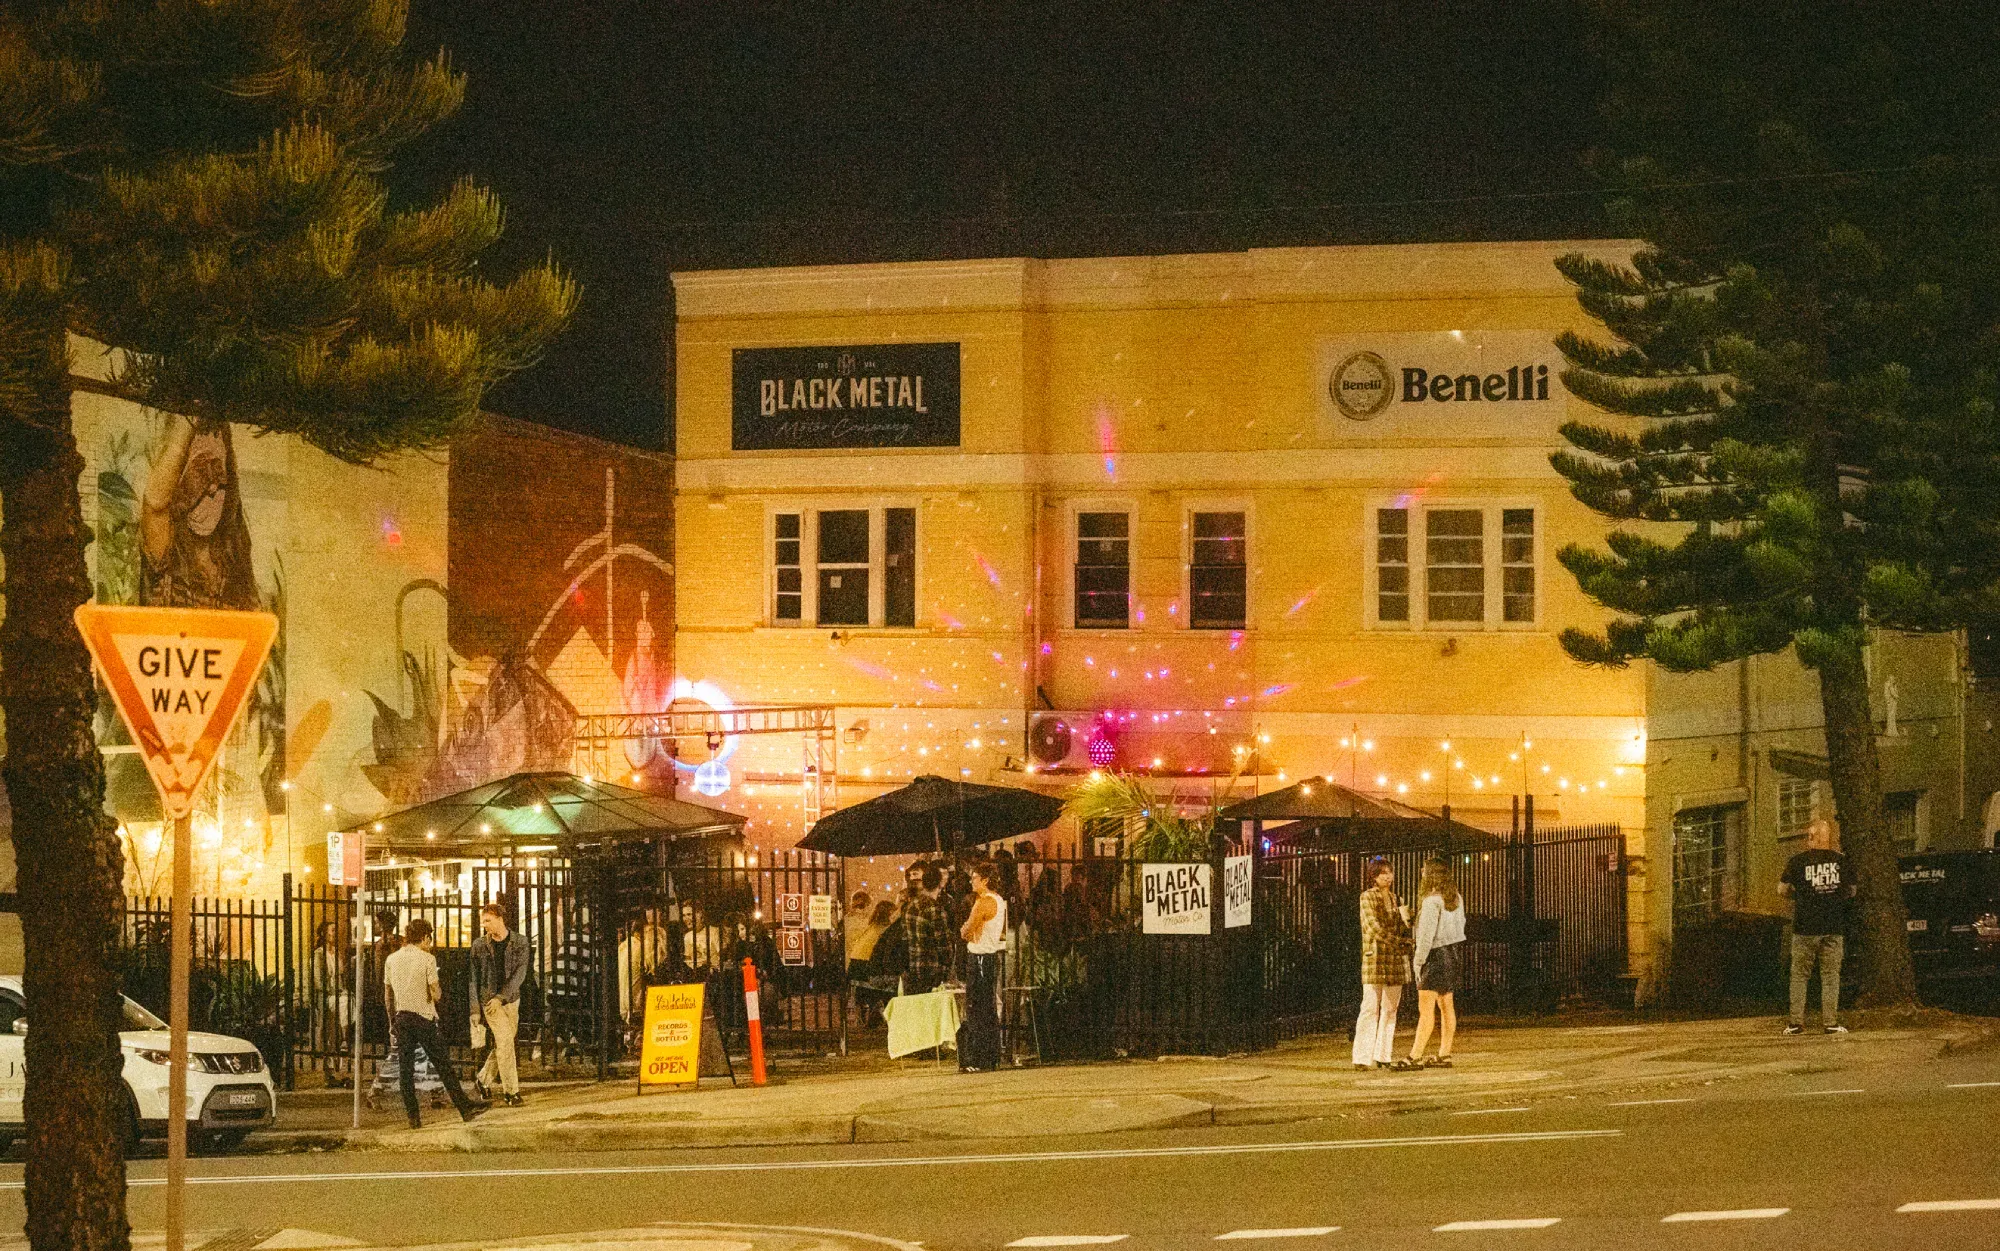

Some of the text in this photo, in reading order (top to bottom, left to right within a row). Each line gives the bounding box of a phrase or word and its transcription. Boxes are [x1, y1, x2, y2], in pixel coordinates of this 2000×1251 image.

[760, 375, 928, 417] BLACK METAL
[1342, 378, 1382, 391] Benelli
[1401, 364, 1549, 402] Benelli
[831, 418, 910, 442] Company
[139, 646, 222, 679] GIVE
[151, 688, 211, 714] WAY
[1145, 865, 1201, 904] BLACK
[1226, 858, 1249, 897] BLACK
[1805, 862, 1838, 881] BLACK
[1811, 872, 1841, 887] METAL
[1156, 886, 1209, 917] METAL
[1229, 880, 1251, 910] METAL
[655, 1035, 688, 1043] BOTTLE-O
[658, 1022, 688, 1031] RECORDS
[648, 1061, 689, 1075] OPEN
